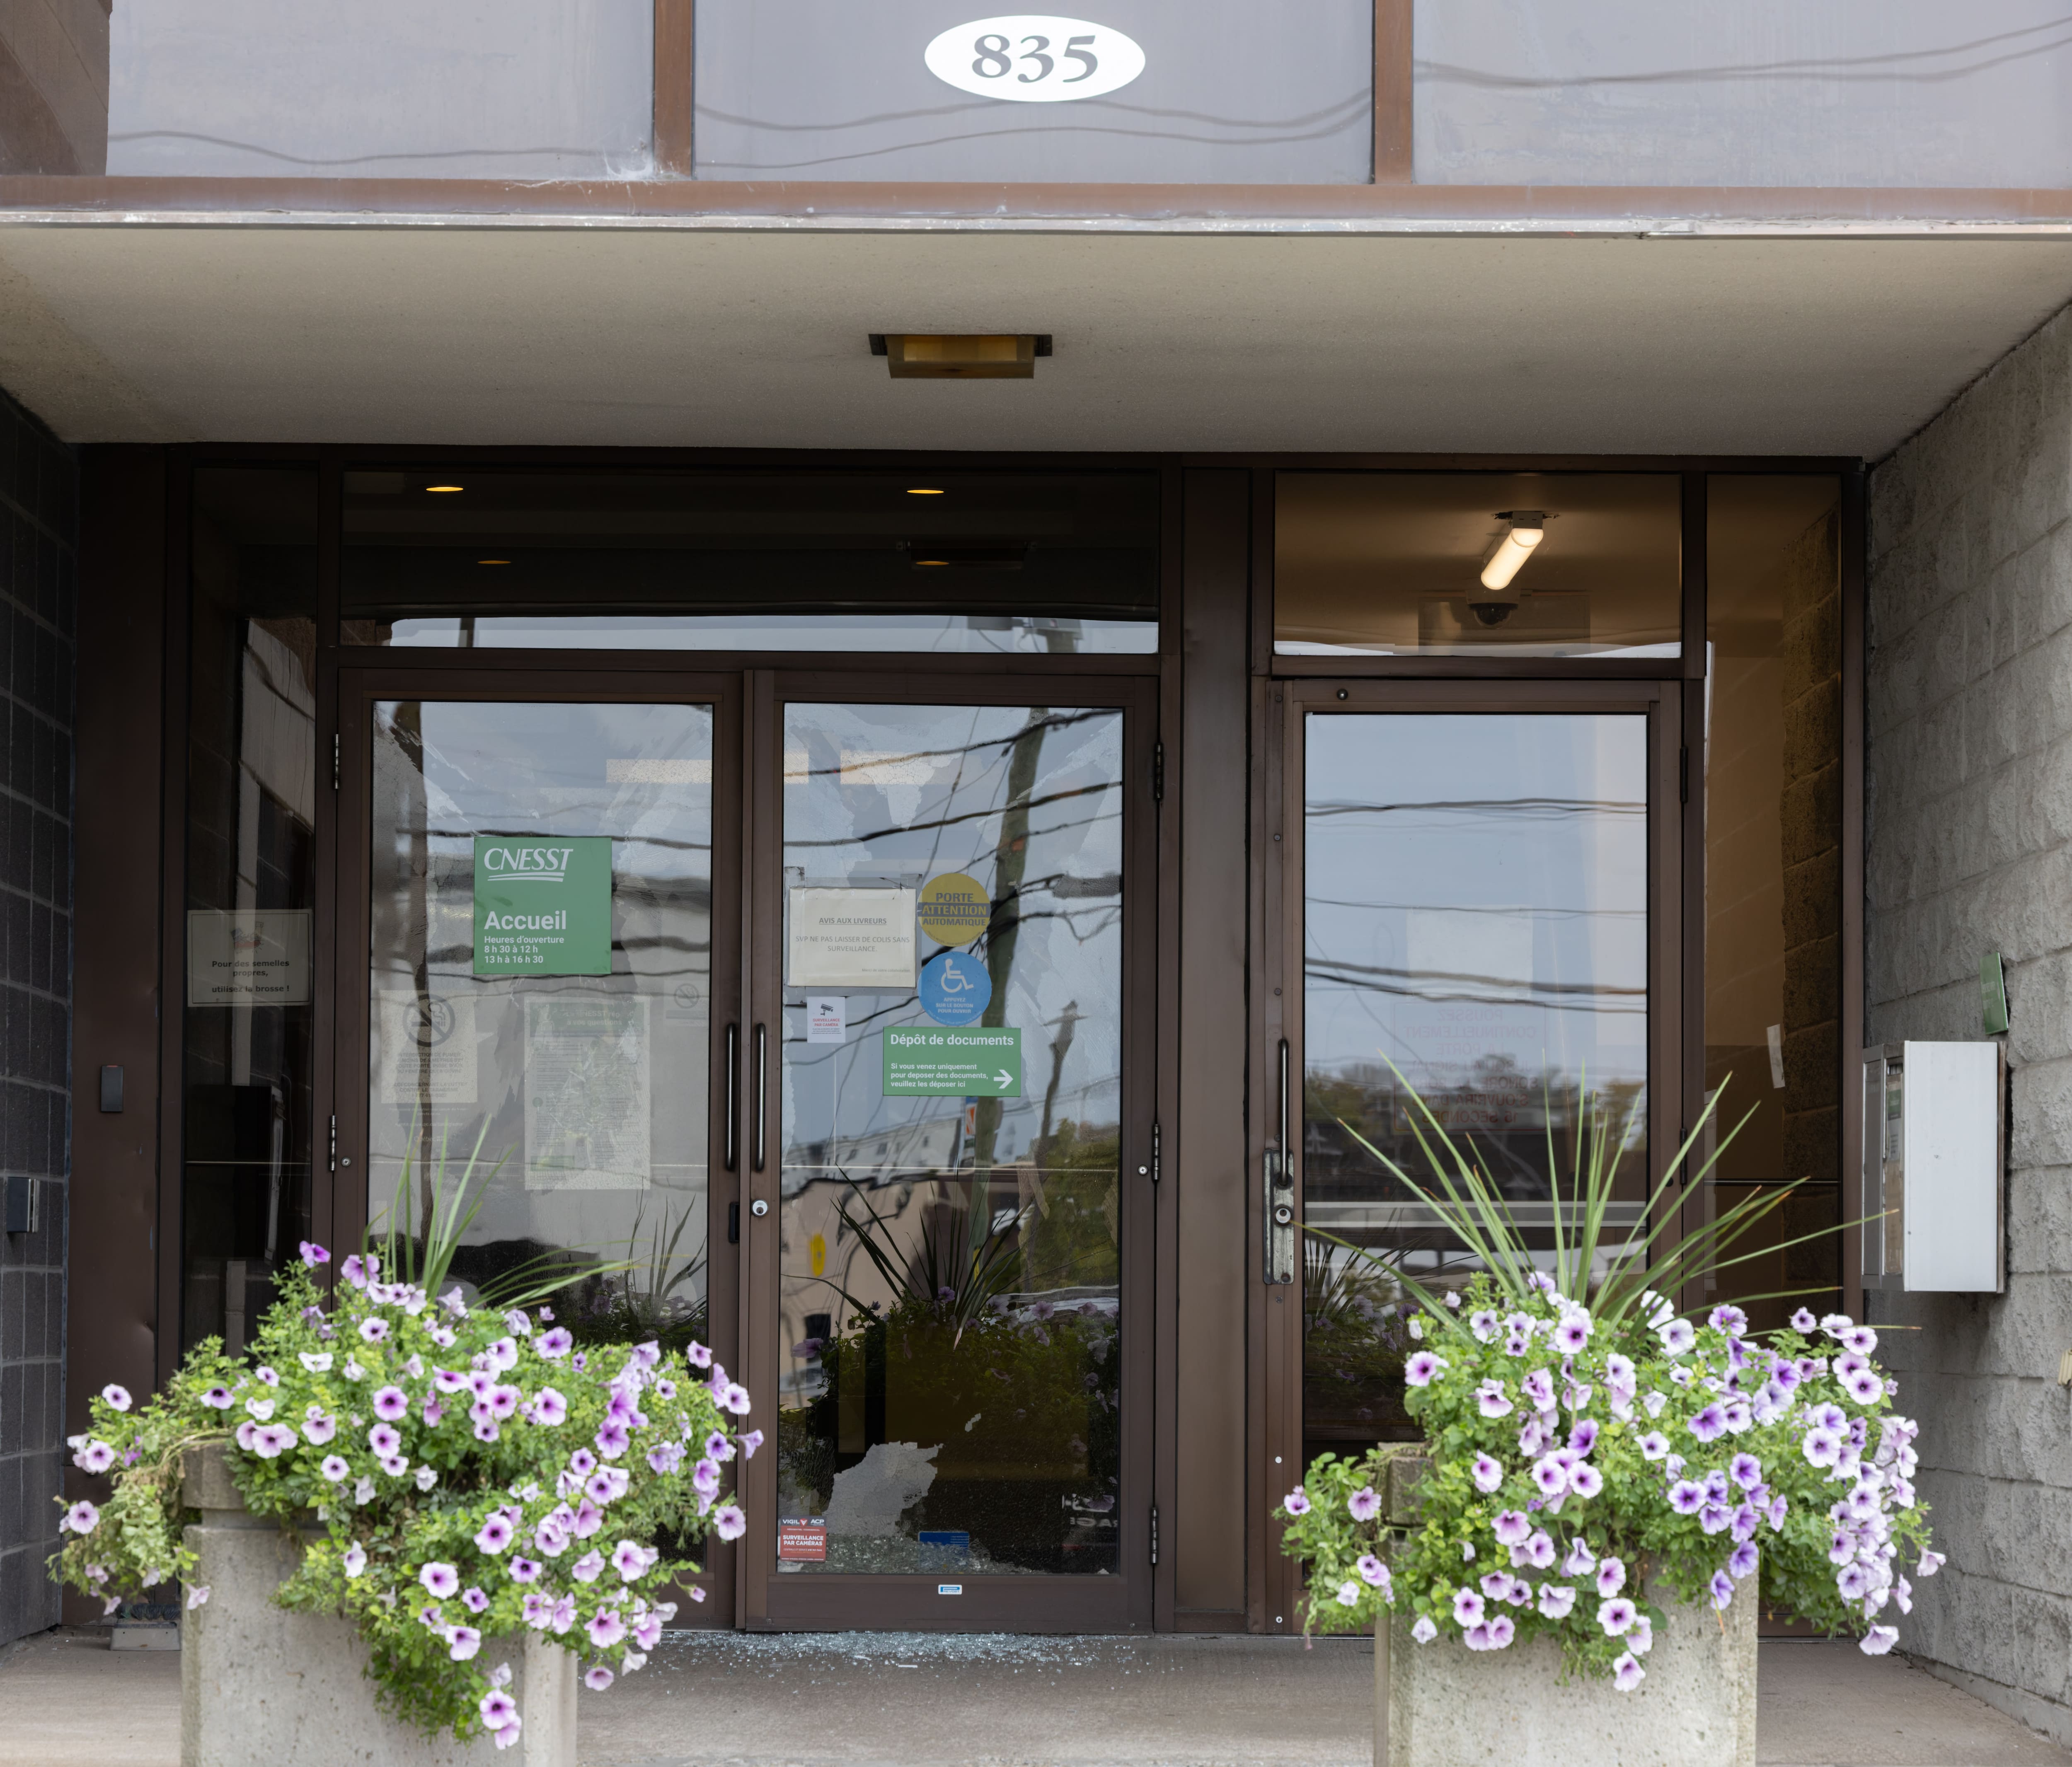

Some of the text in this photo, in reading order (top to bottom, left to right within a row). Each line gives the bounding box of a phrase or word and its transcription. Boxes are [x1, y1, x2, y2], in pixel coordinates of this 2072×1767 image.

[972, 34, 1098, 83] 835
[484, 848, 574, 870] CNESST
[935, 892, 974, 902] PORTE
[922, 904, 987, 916] ATTENTION
[484, 910, 566, 930] Accueil
[922, 917, 986, 927] AUTOMATIQUE
[513, 945, 518, 953] à
[504, 955, 510, 964] à
[891, 1034, 1014, 1047] Dépôt de documents
